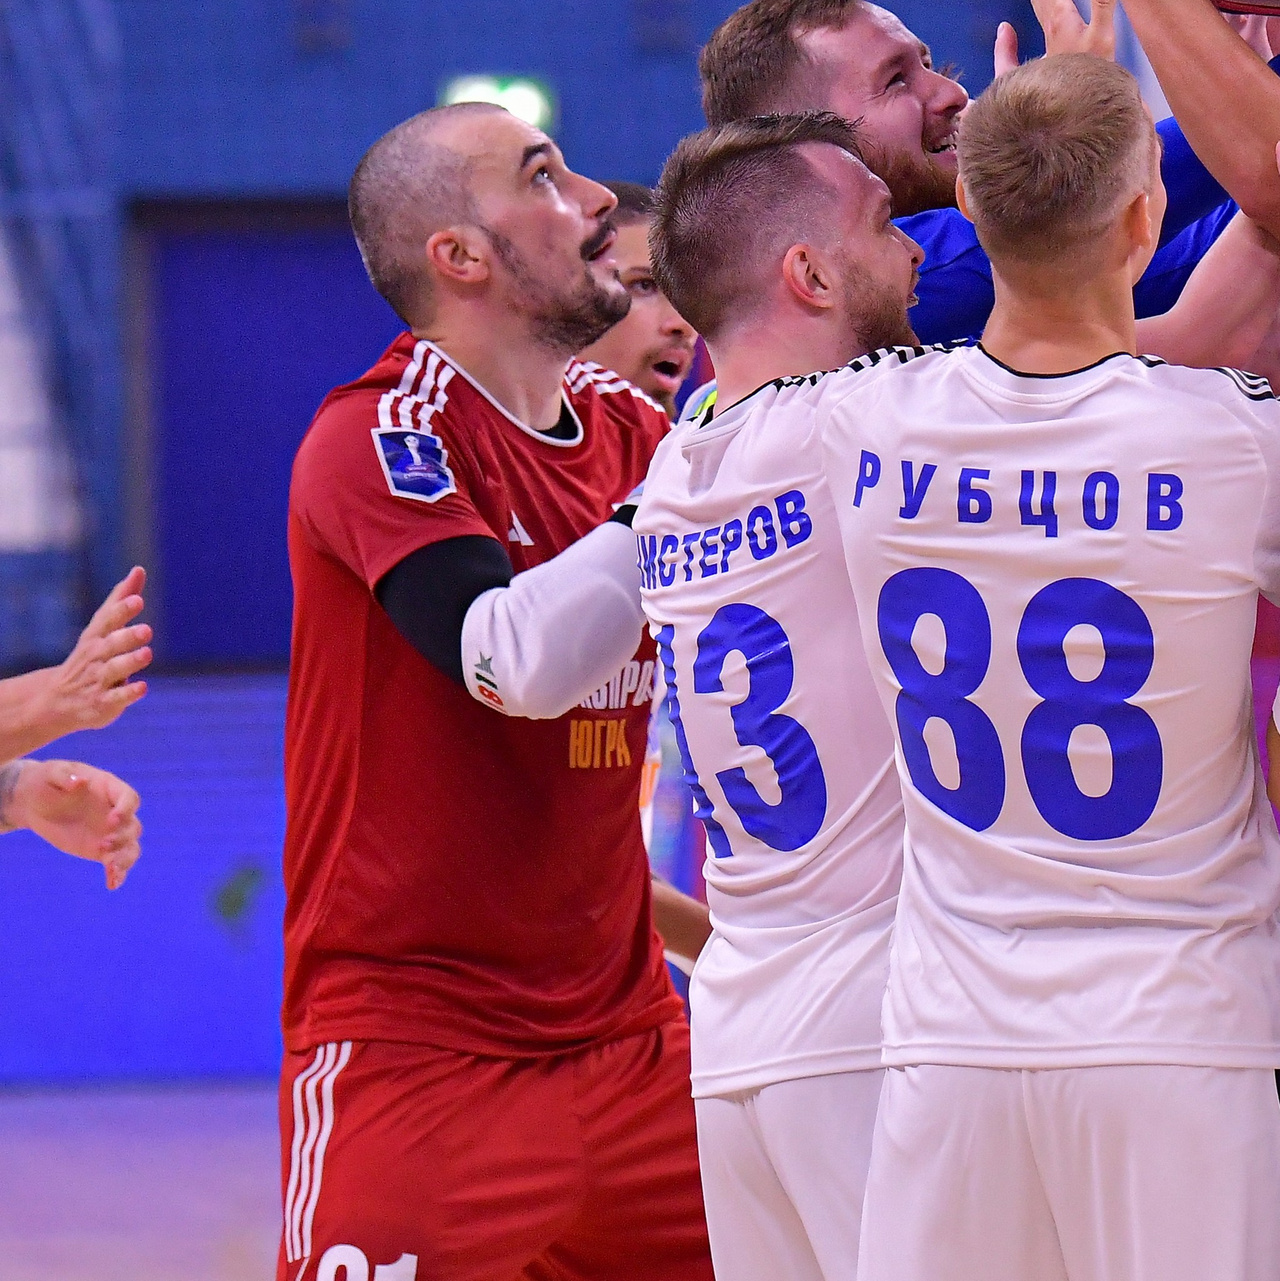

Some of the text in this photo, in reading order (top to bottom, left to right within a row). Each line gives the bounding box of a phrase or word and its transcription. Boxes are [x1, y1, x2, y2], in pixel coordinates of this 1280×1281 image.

[852, 449, 1184, 538] РУБЦОВ
[569, 719, 632, 768] ЮГРА
[877, 567, 1163, 841] 88
